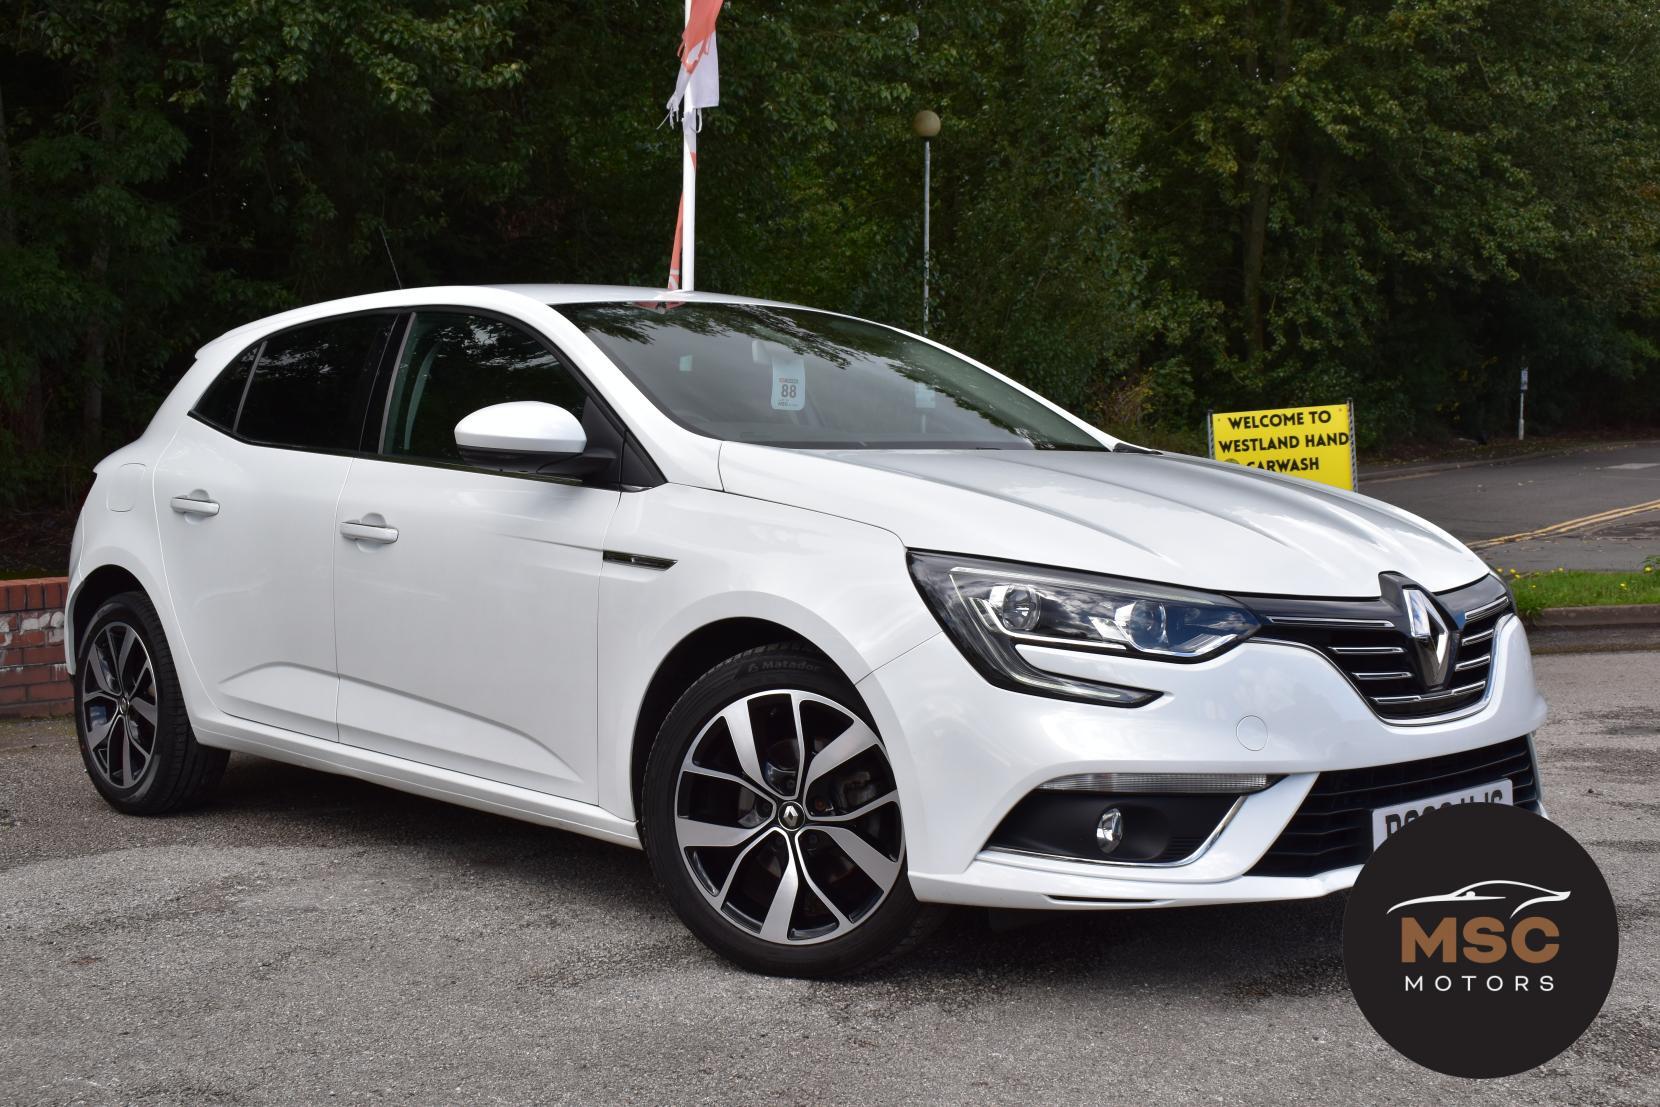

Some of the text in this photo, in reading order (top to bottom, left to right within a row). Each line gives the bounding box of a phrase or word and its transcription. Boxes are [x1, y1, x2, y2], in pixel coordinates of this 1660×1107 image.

[781, 384, 797, 398] 88
[1228, 410, 1332, 430] WELCOME TO
[1218, 432, 1349, 453] WESTLAND HAND
[762, 659, 821, 672] Matador
